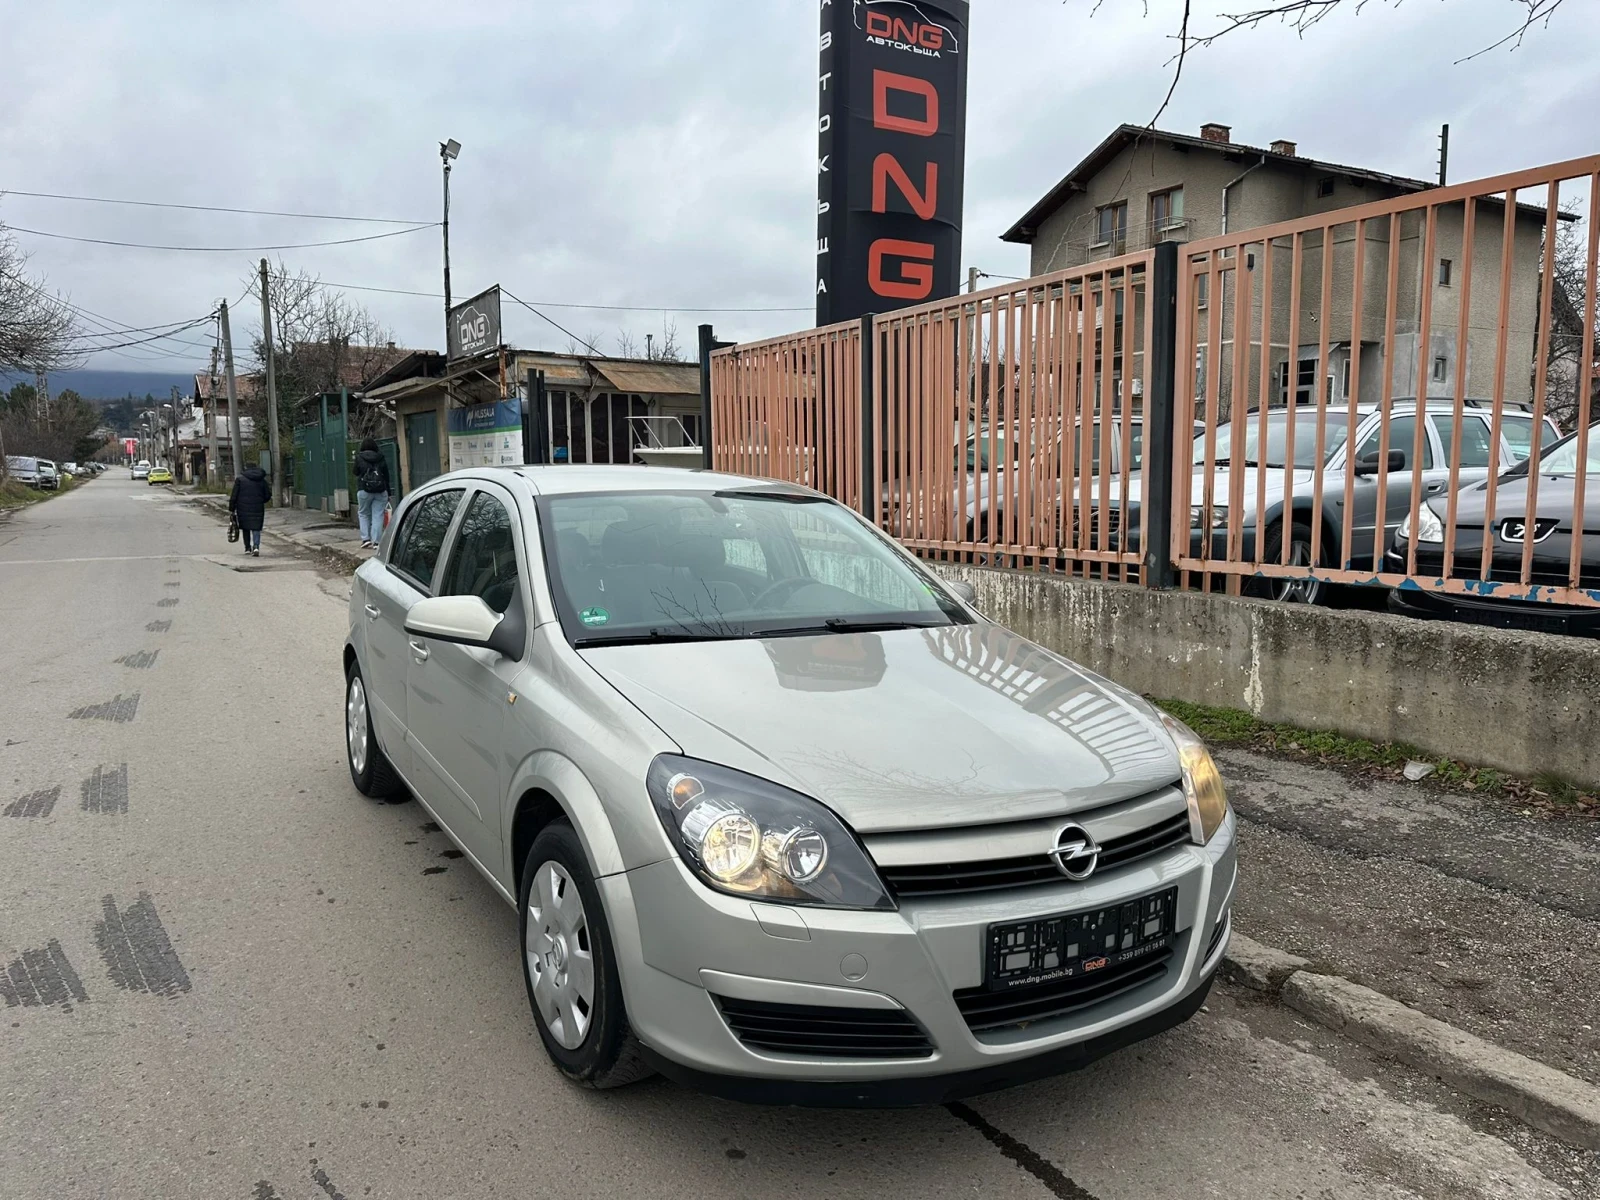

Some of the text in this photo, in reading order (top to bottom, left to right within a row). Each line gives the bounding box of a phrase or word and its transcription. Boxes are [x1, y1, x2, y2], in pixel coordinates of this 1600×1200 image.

[866, 11, 943, 49] DNG
[866, 35, 941, 58] АВТОКЪЩА
[868, 69, 939, 300] DNG
[461, 316, 485, 344] DNG
[1118, 951, 1133, 961] +359
[1008, 968, 1073, 986] www.dng.mobile.bg
